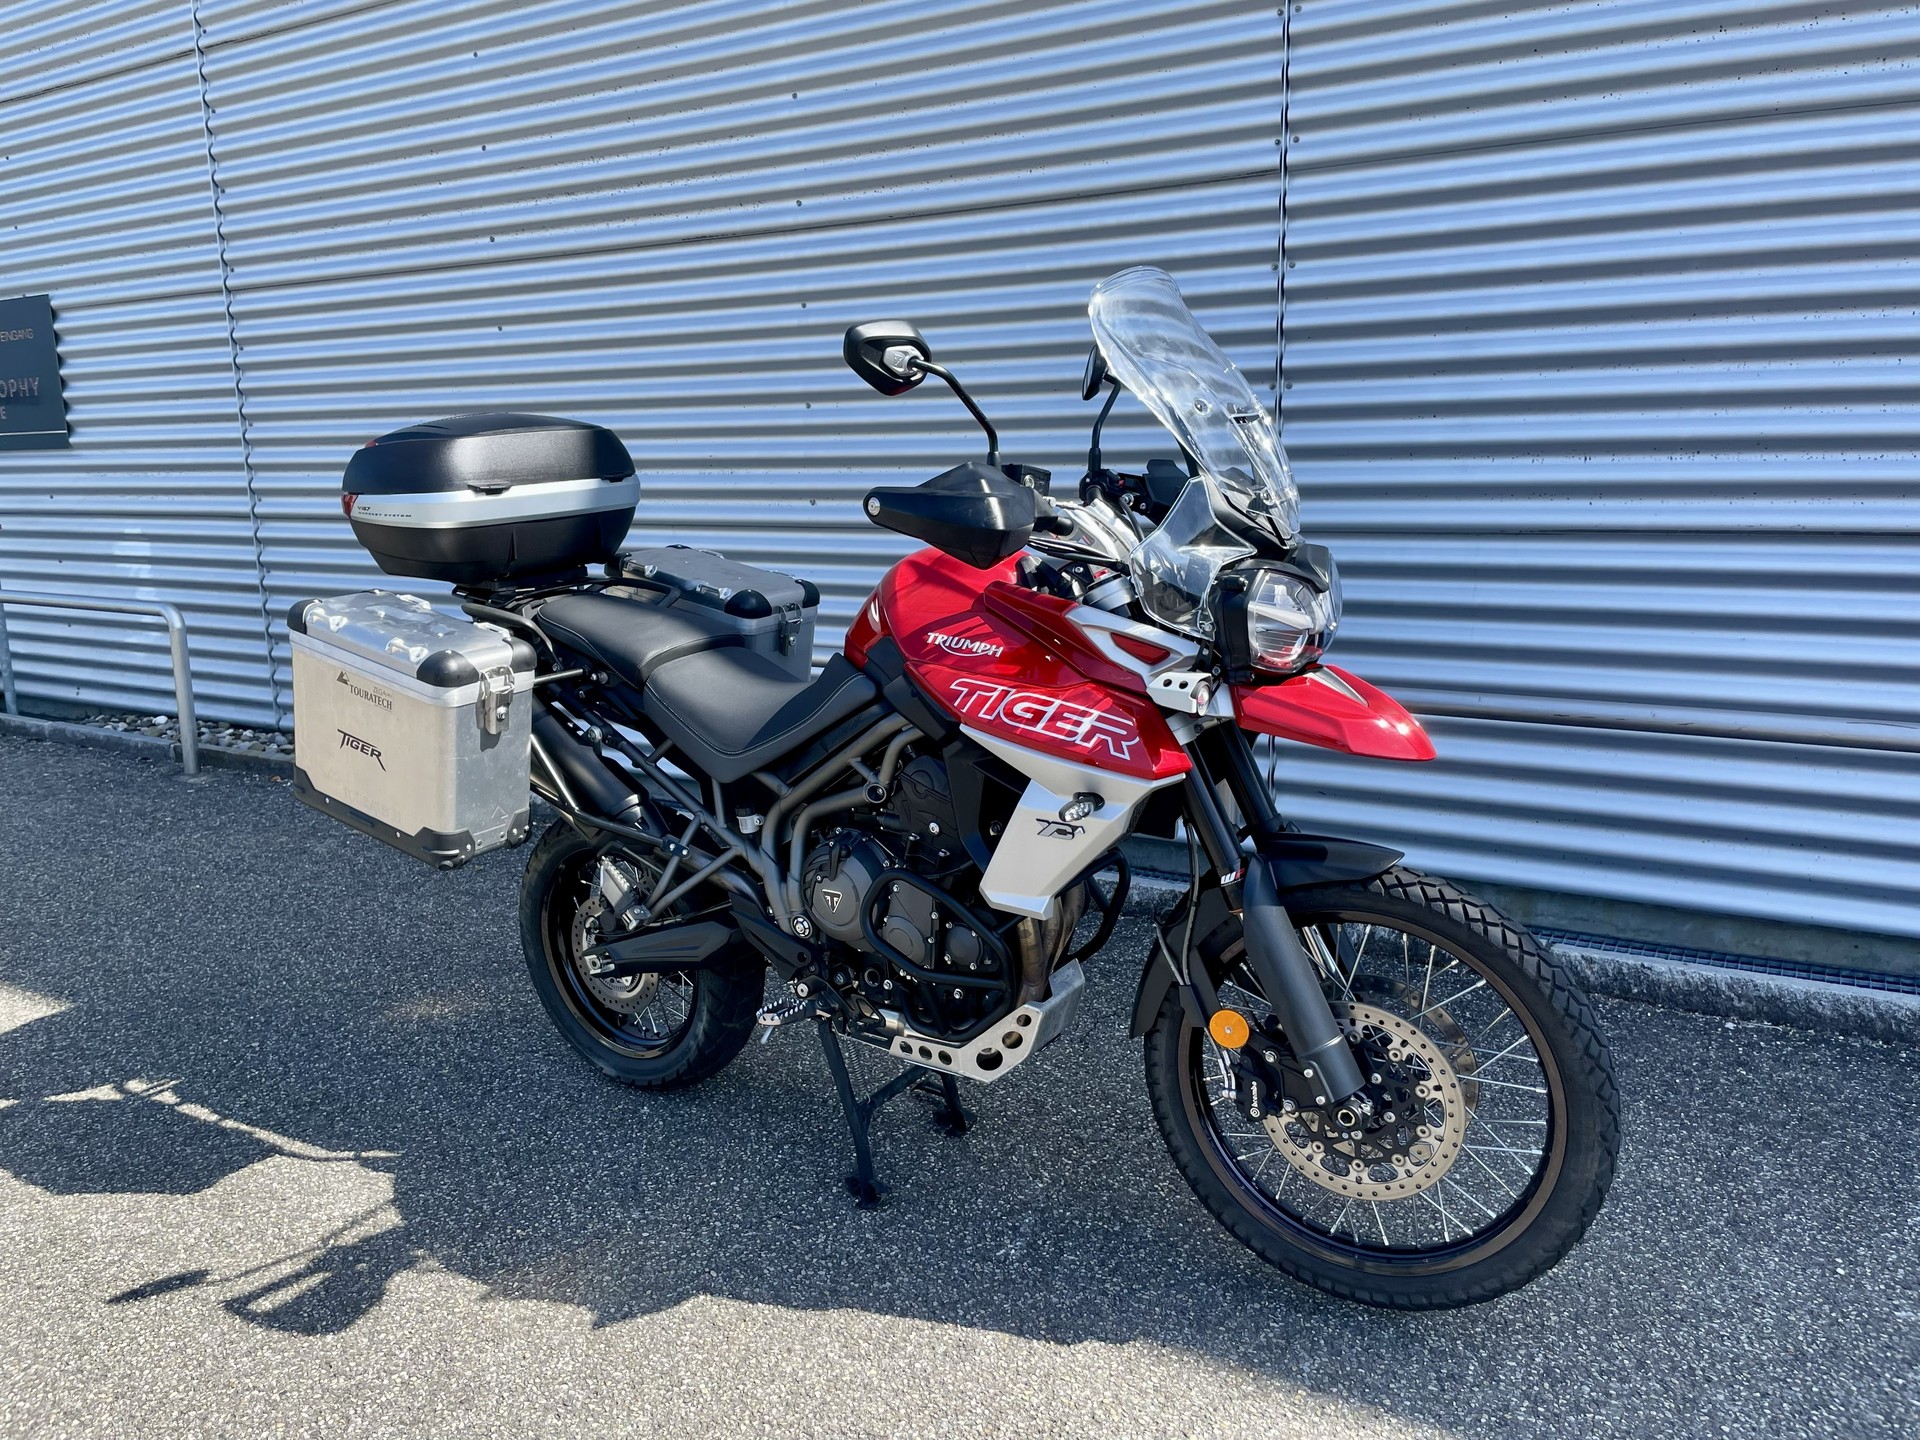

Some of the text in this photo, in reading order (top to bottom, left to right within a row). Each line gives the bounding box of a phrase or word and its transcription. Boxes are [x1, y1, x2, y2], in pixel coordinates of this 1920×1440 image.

[926, 632, 1004, 658] TRIUMPH
[349, 684, 393, 710] TOURATECH
[949, 678, 1140, 761] TIGER
[337, 728, 387, 773] TIGER
